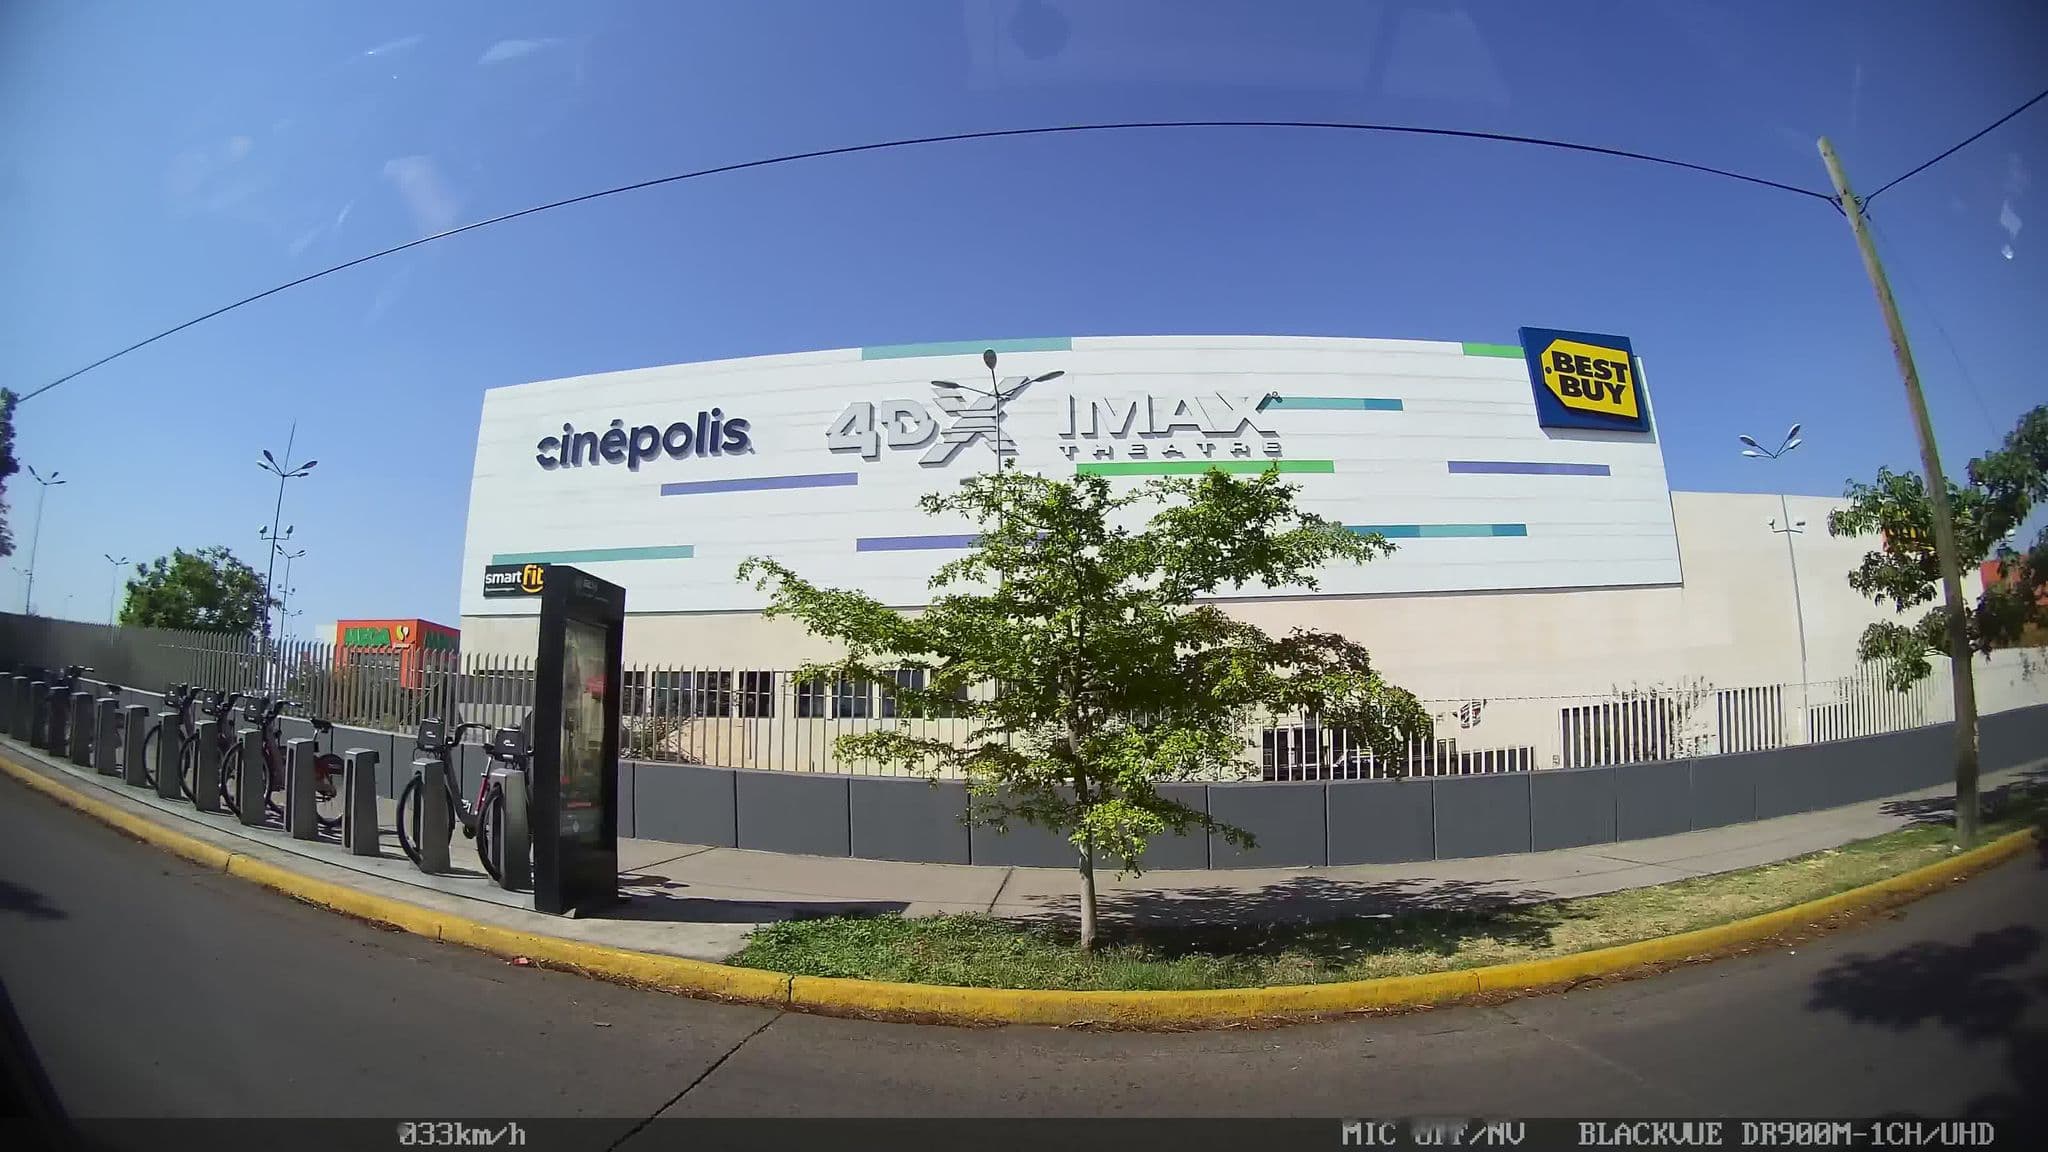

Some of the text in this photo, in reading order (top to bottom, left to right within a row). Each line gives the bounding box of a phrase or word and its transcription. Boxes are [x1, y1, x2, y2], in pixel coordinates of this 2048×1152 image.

[1551, 350, 1628, 383] BEST
[1558, 374, 1626, 405] BUY
[826, 375, 1032, 469] 4DX
[1057, 391, 1281, 439] IMAX
[535, 407, 753, 473] cinépolis
[1058, 442, 1283, 461] THEATRE
